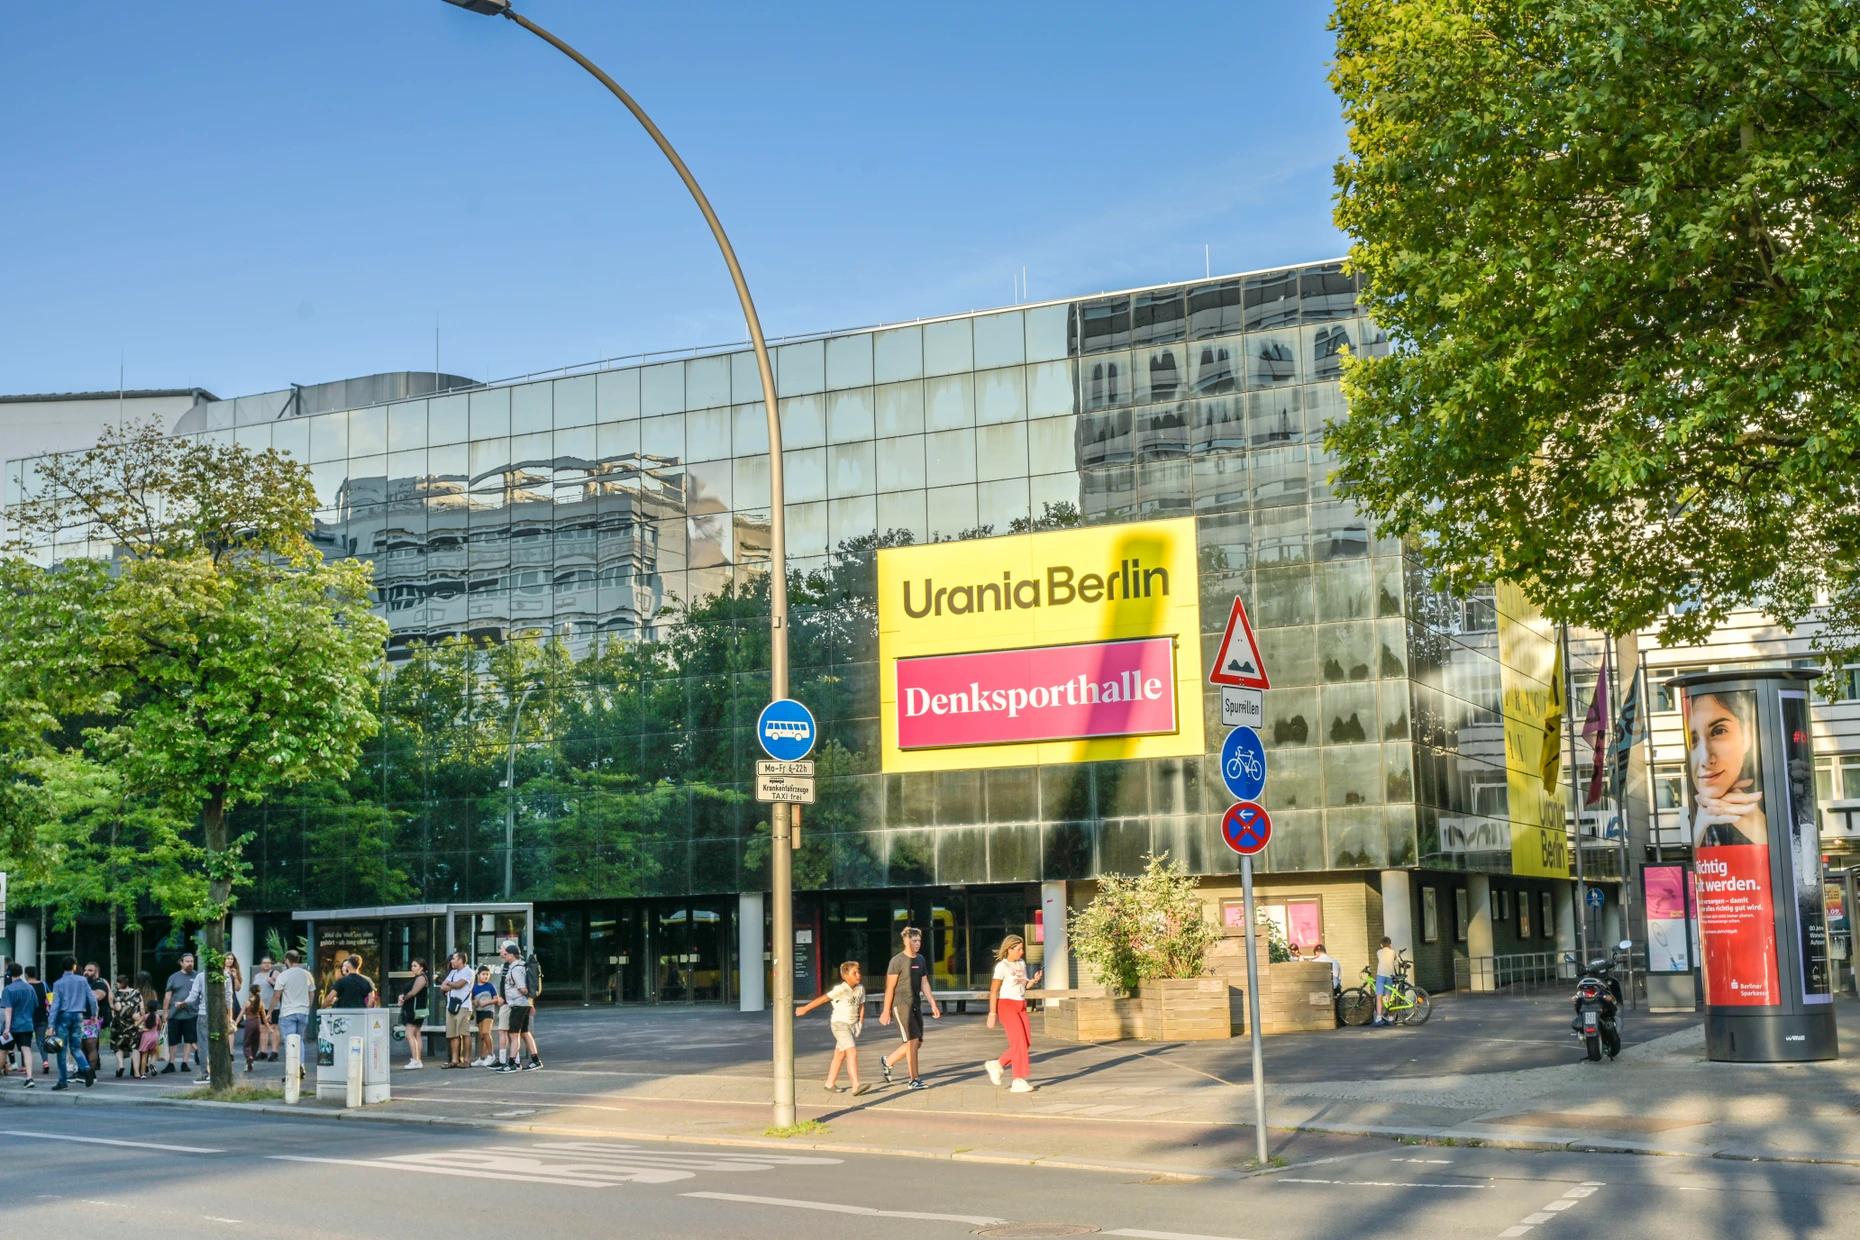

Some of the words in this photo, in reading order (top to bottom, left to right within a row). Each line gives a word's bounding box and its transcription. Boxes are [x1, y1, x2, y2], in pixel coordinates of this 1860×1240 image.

[904, 669, 1163, 718] Denksporthalle
[1225, 698, 1260, 716] Spurrillen
[1507, 730, 1524, 763] AN
[763, 784, 809, 794] Krankenfahrzeuge
[790, 793, 802, 801] frei
[1540, 830, 1566, 870] Berlin
[1705, 876, 1761, 892] werden.
[1715, 904, 1734, 913] richtig
[1734, 904, 1746, 912] gut
[1746, 903, 1764, 911] wird.
[374, 1141, 846, 1184] BUS
